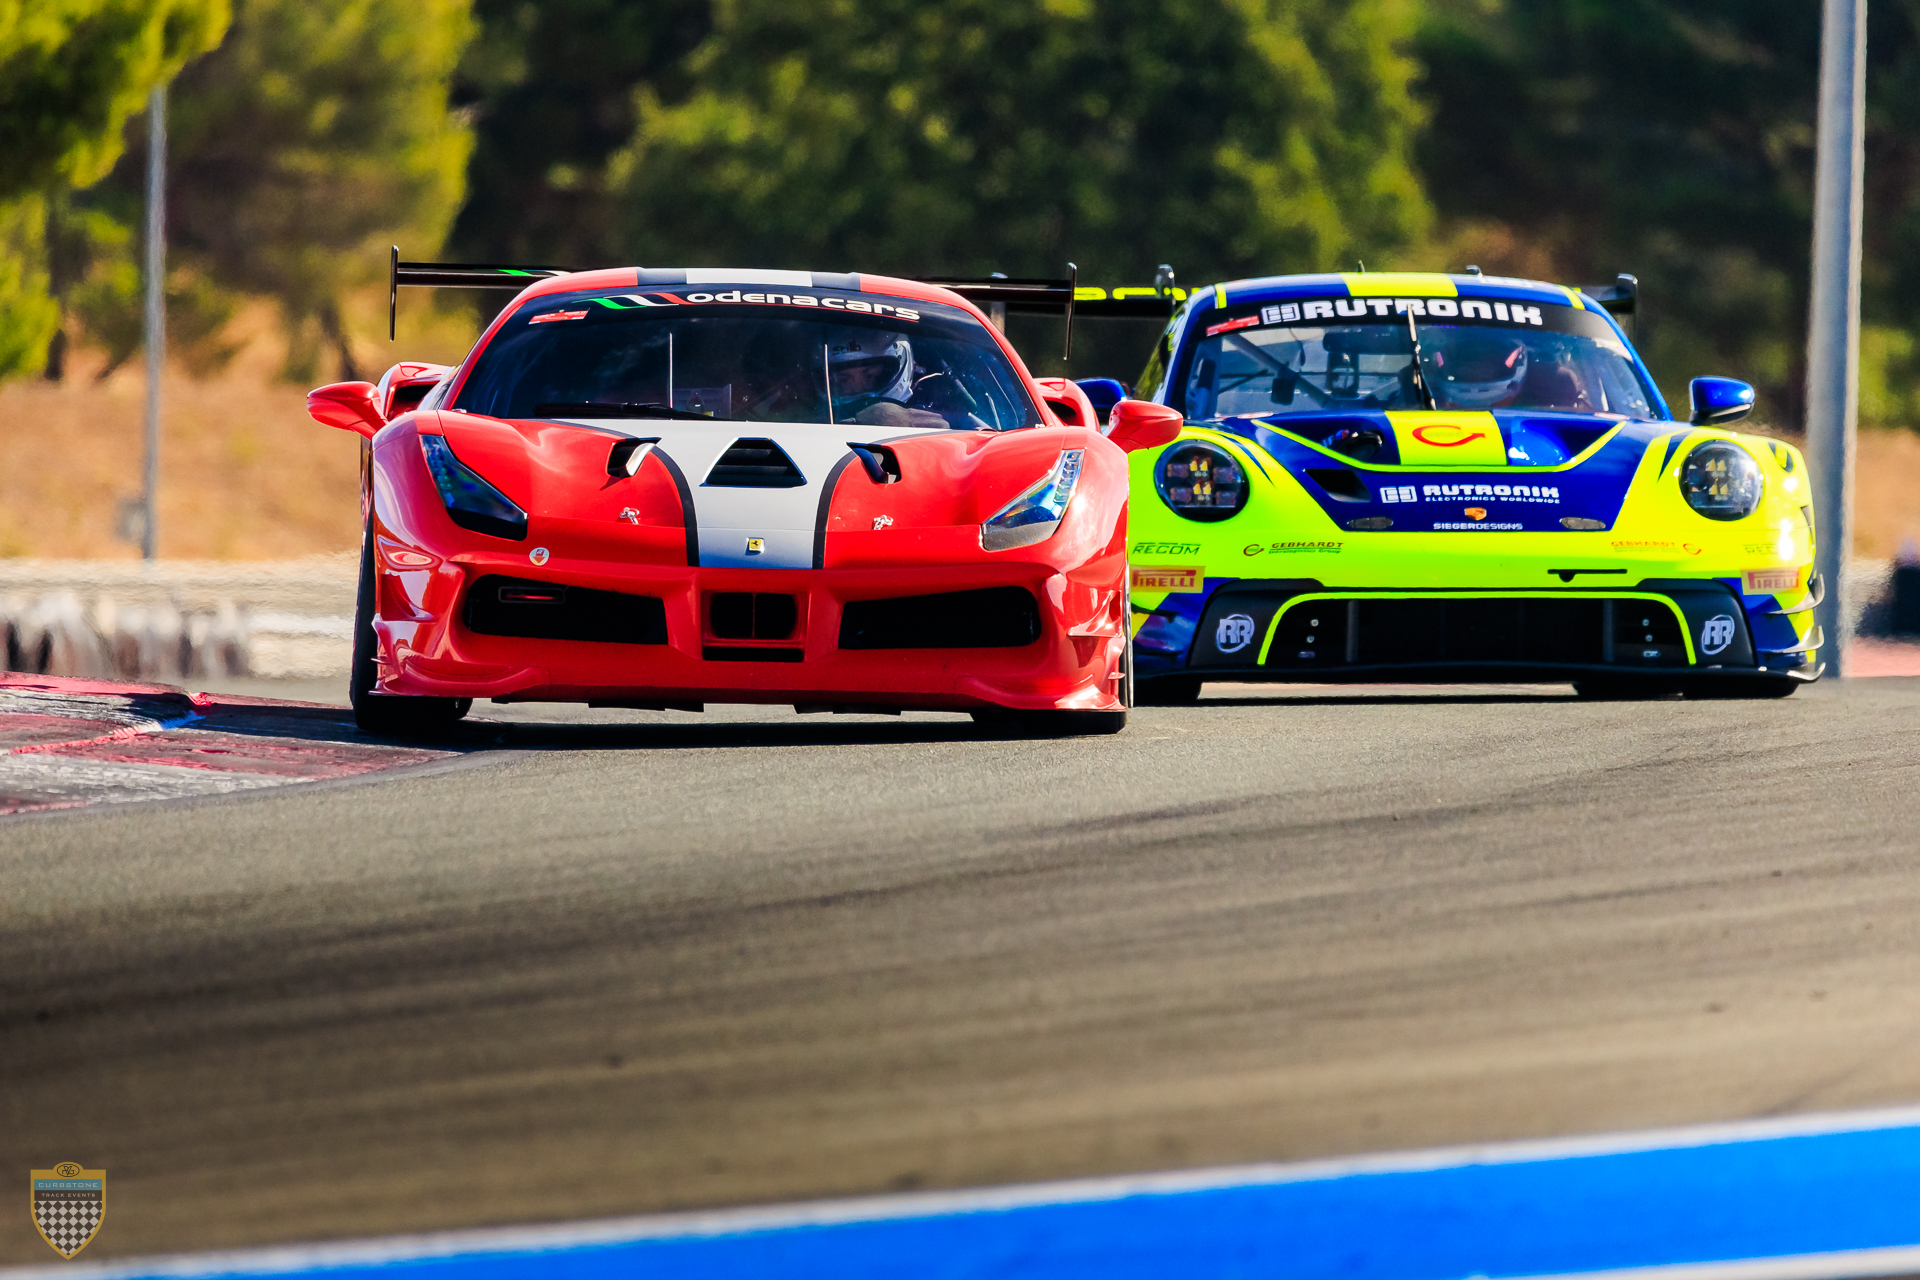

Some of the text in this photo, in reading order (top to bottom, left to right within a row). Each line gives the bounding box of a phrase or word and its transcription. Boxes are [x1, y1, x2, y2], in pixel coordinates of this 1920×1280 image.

[1302, 298, 1543, 326] RUTRONIK
[1423, 484, 1560, 499] RUTRONIK
[1499, 496, 1560, 504] WORLDWIDE
[1433, 522, 1523, 530] SIEGERDESIGNS
[1132, 543, 1201, 555] RECOM
[1271, 541, 1344, 549] GEBHARDT
[1132, 569, 1197, 588] PIRELLI
[1747, 570, 1799, 590] PIRELLI
